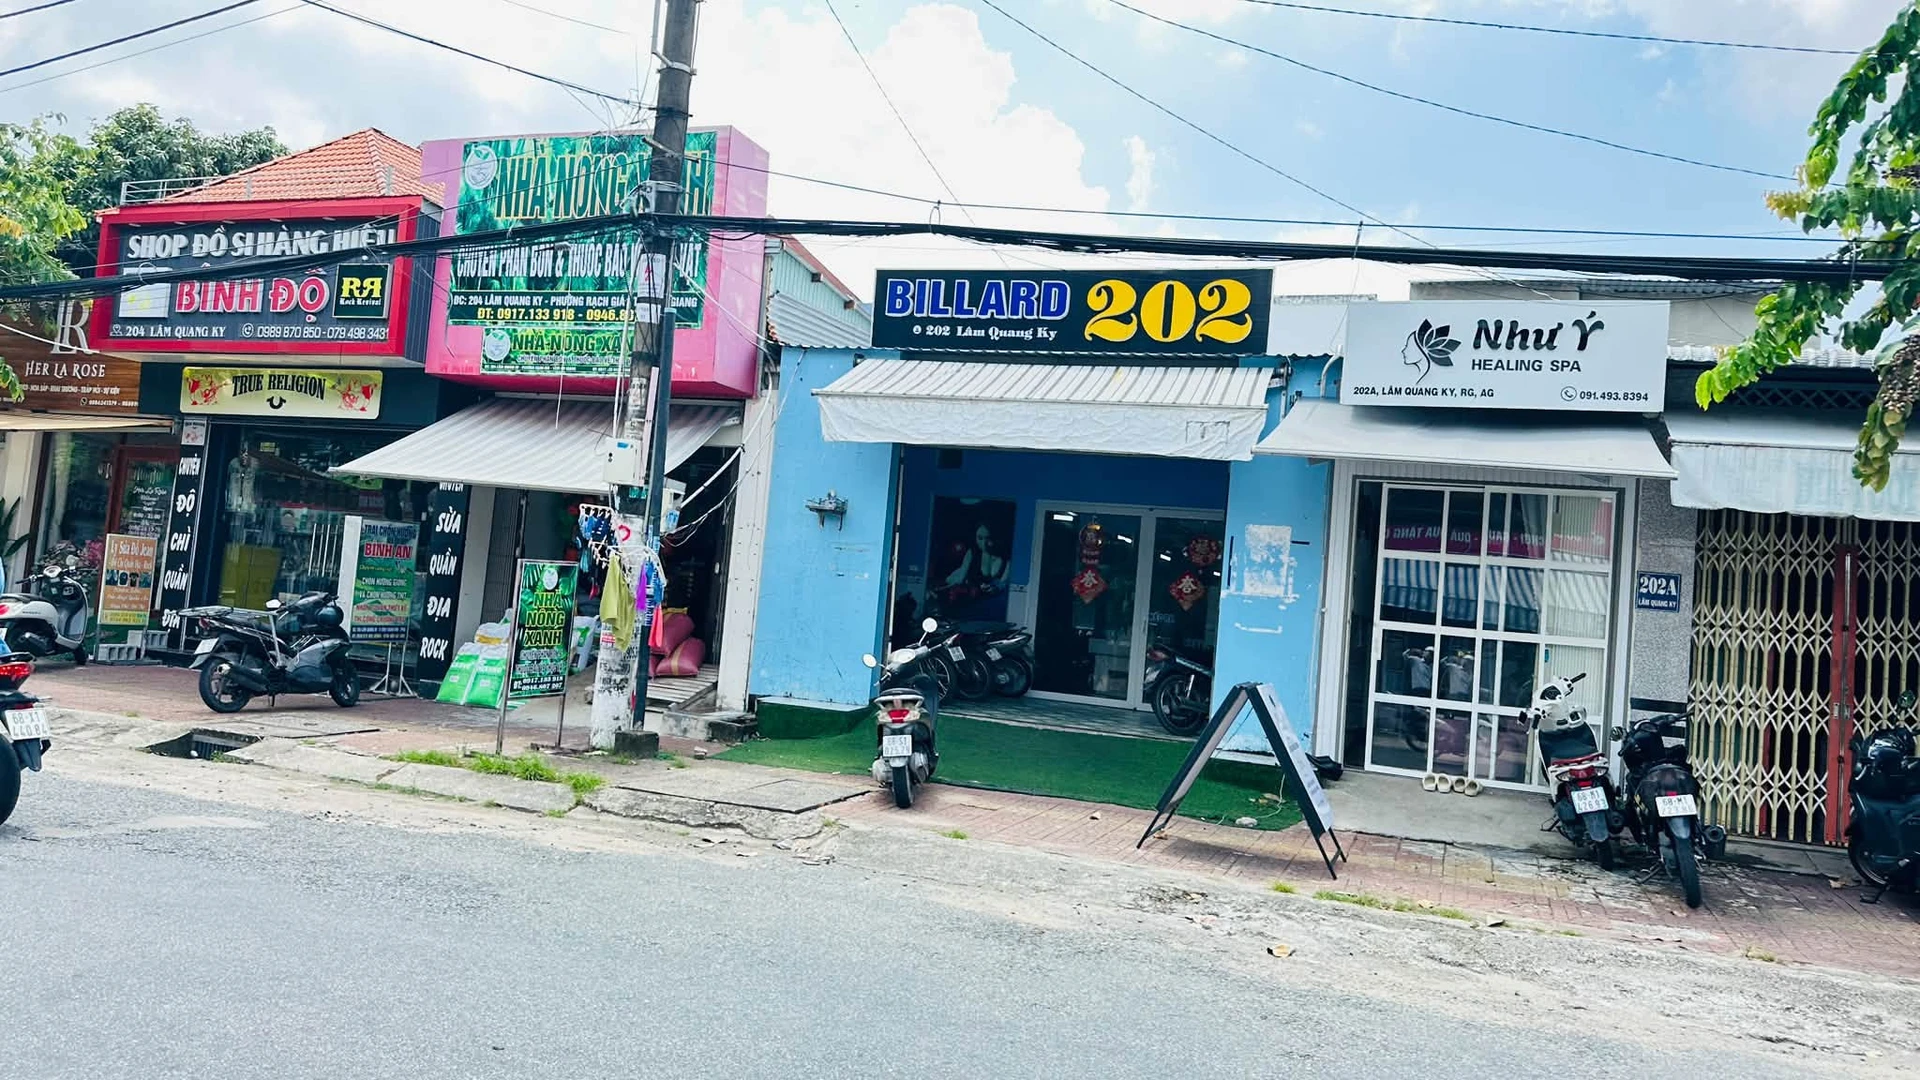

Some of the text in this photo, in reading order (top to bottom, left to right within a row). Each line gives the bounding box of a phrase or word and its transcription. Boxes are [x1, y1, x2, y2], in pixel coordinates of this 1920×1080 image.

[127, 234, 189, 259] SHOP
[192, 225, 229, 257] ĐỒ
[231, 232, 255, 257] SI
[255, 224, 329, 256] HÀNG
[468, 296, 483, 306] 204
[485, 294, 502, 306] LÂM
[504, 296, 531, 306] QUANG
[532, 296, 543, 306] KY
[586, 296, 609, 309] RẠCH
[497, 308, 550, 320] 0917.133
[553, 309, 575, 320] 918
[885, 278, 1254, 345] BILLARD 202
[126, 324, 226, 339] 204 LÂM QUANG KY
[257, 326, 281, 338] 0989
[284, 326, 301, 338] 870
[347, 327, 366, 339] 498
[924, 325, 1058, 342] 202 Lâm Quang Ky
[1472, 310, 1606, 352] Như Ý
[601, 335, 634, 353] XAN
[25, 360, 107, 379] HER LA ROSE
[1471, 359, 1582, 373] HEALING SPA
[232, 374, 327, 400] TRUE RELIGION
[1353, 384, 1495, 400] 202A, LÂM QUANG KY, RG, AG
[1579, 390, 1650, 402] 091.493.8394
[176, 488, 196, 518] ĐỘ
[429, 547, 458, 577] QUẦN
[164, 564, 189, 591] QUẦN
[1639, 576, 1677, 596] 202A
[533, 589, 563, 608] NHÀ
[427, 597, 452, 622] ĐỊA
[525, 609, 565, 627] NÔNG
[524, 629, 563, 646] XANH
[420, 636, 449, 661] ROCK
